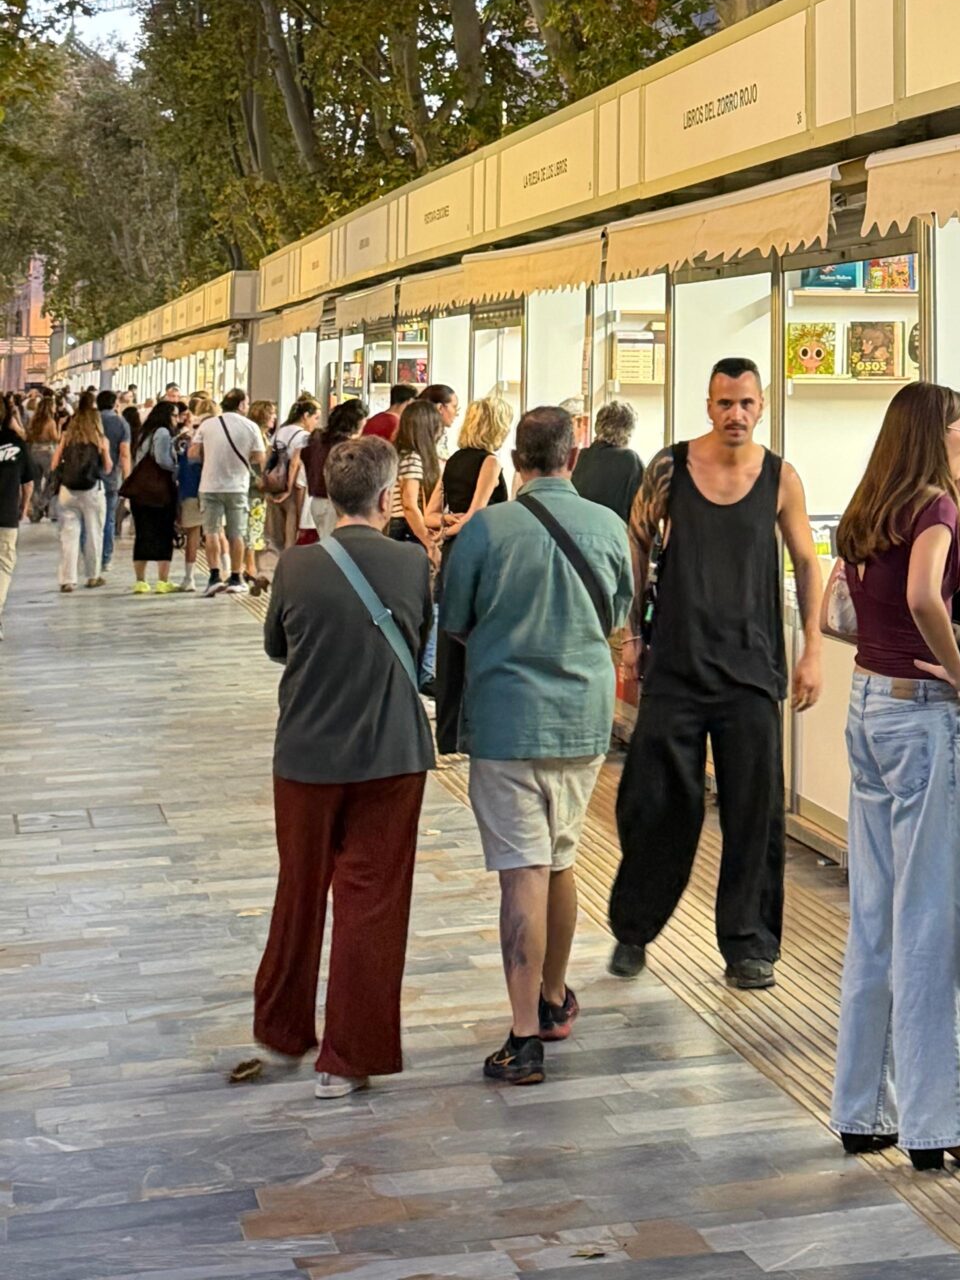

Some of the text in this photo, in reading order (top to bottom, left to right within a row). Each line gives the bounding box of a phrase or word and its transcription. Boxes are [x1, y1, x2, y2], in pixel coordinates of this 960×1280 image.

[683, 83, 758, 130] LIBROS DEL ZORRO ROJO
[856, 361, 887, 371] OSOS
